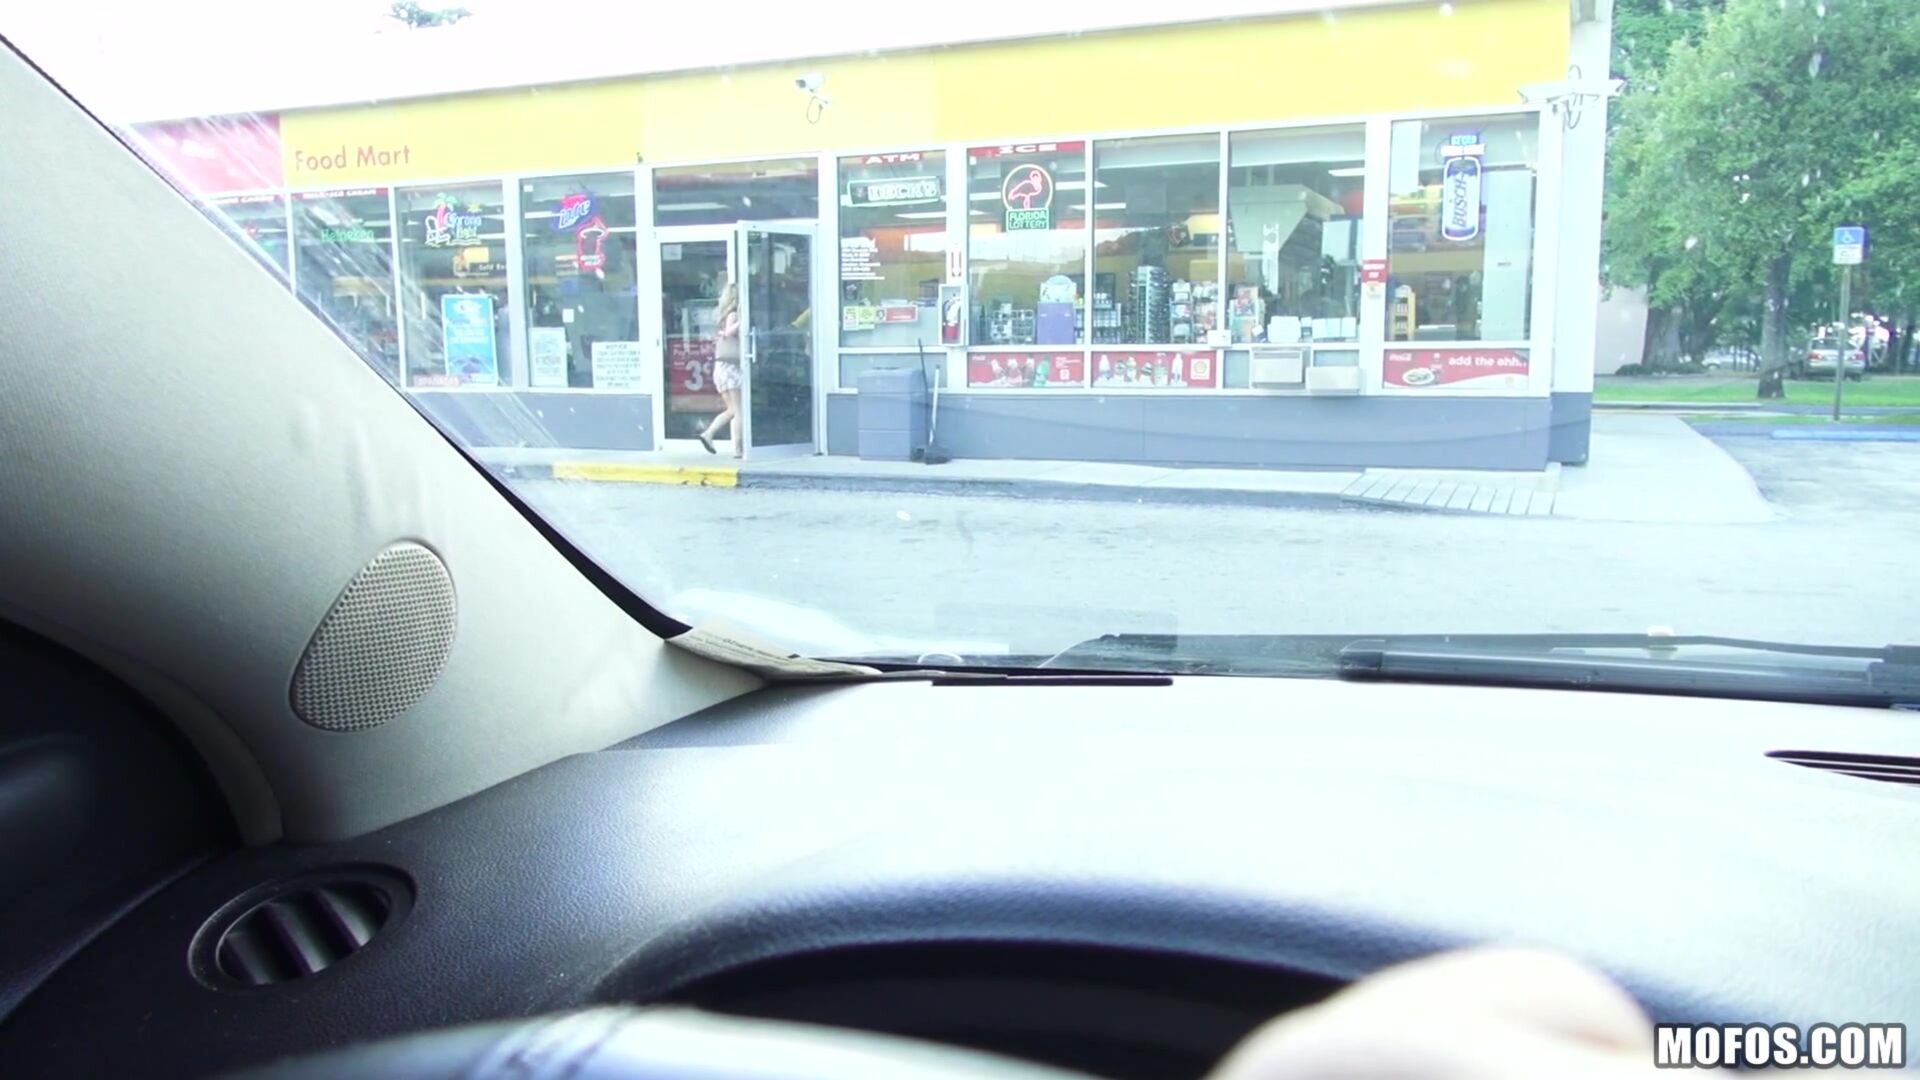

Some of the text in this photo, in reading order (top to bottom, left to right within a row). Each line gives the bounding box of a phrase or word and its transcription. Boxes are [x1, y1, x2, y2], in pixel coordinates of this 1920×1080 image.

[1000, 144, 1057, 154] ICE
[295, 144, 410, 171] Food Mart
[865, 153, 920, 165] ATM
[1452, 172, 1468, 229] BUSCH
[1009, 211, 1047, 221] FLORIDA
[1009, 220, 1047, 230] LOTTERY
[320, 228, 375, 242] Heineken
[1448, 355, 1472, 366] add
[1475, 355, 1495, 367] the
